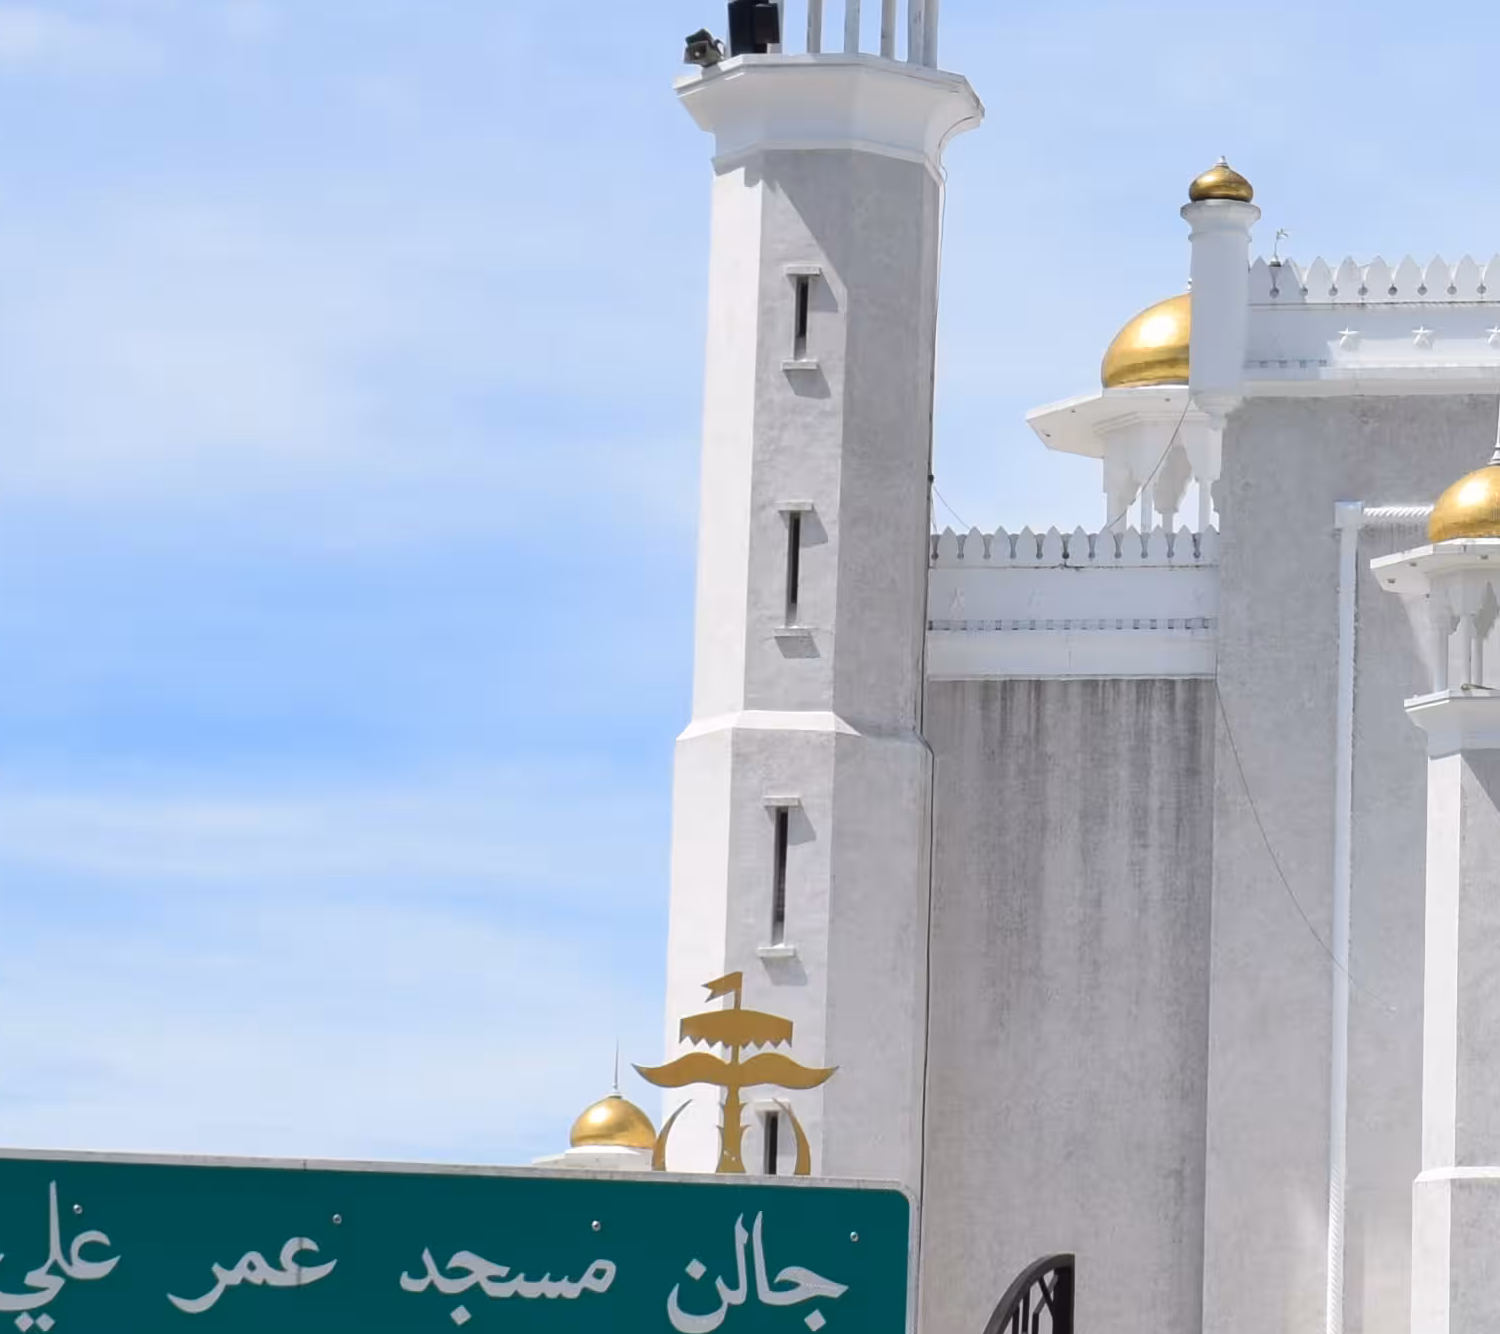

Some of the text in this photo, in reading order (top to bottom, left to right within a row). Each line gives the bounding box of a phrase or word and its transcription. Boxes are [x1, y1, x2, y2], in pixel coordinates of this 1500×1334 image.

[166, 1236, 338, 1314] عمر
[399, 1247, 617, 1326] مسجد
[666, 1210, 849, 1334] جالن
